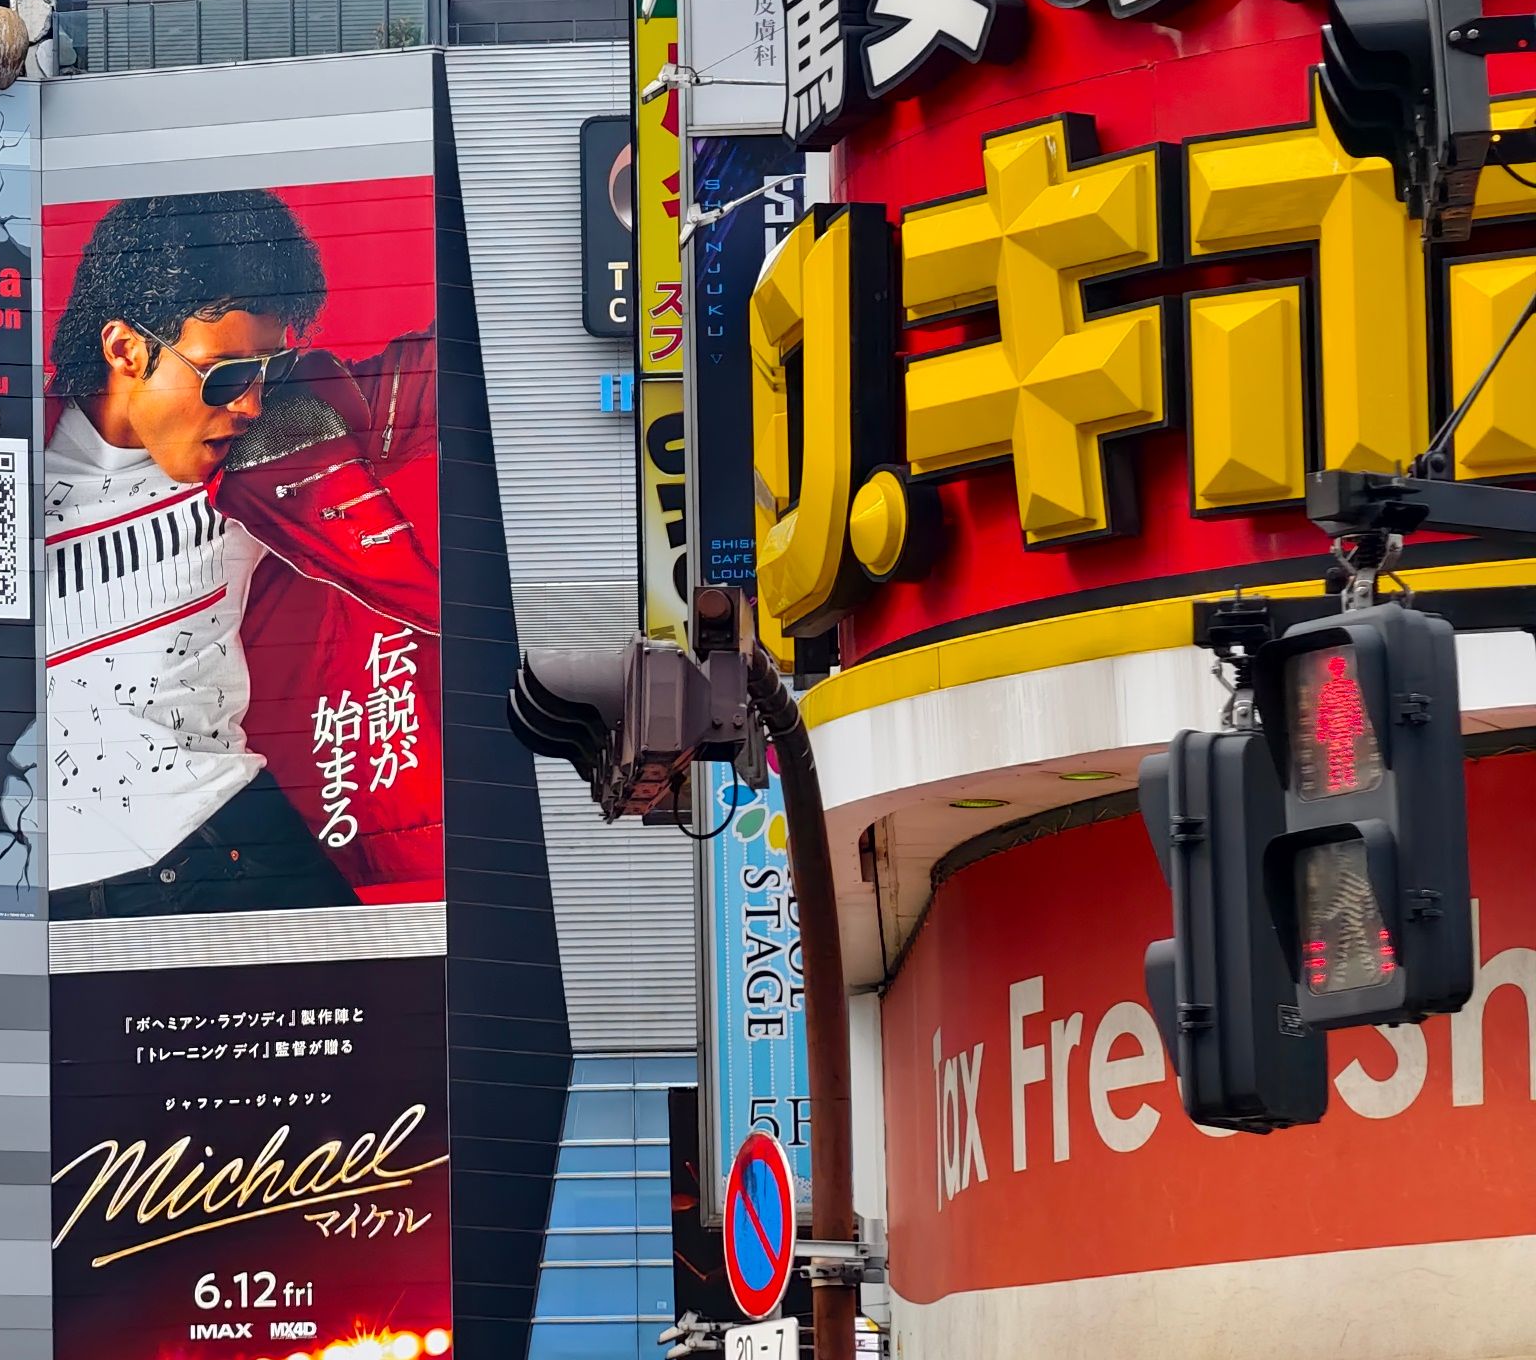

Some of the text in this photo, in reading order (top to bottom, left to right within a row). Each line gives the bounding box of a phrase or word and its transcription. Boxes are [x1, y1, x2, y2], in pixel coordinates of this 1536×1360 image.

[711, 554, 753, 565] CAFE
[365, 628, 421, 793] 伝説が
[311, 691, 363, 849] 始まる
[741, 863, 786, 1041] STAGE
[165, 1092, 332, 1111] ジャファー・ジャクソン
[748, 1098, 811, 1148] 5F
[52, 1104, 450, 1250] Michael
[304, 1203, 433, 1240] マイケル
[194, 1271, 314, 1310] 6.12 fri
[190, 1321, 318, 1340] IMAX MX4D
